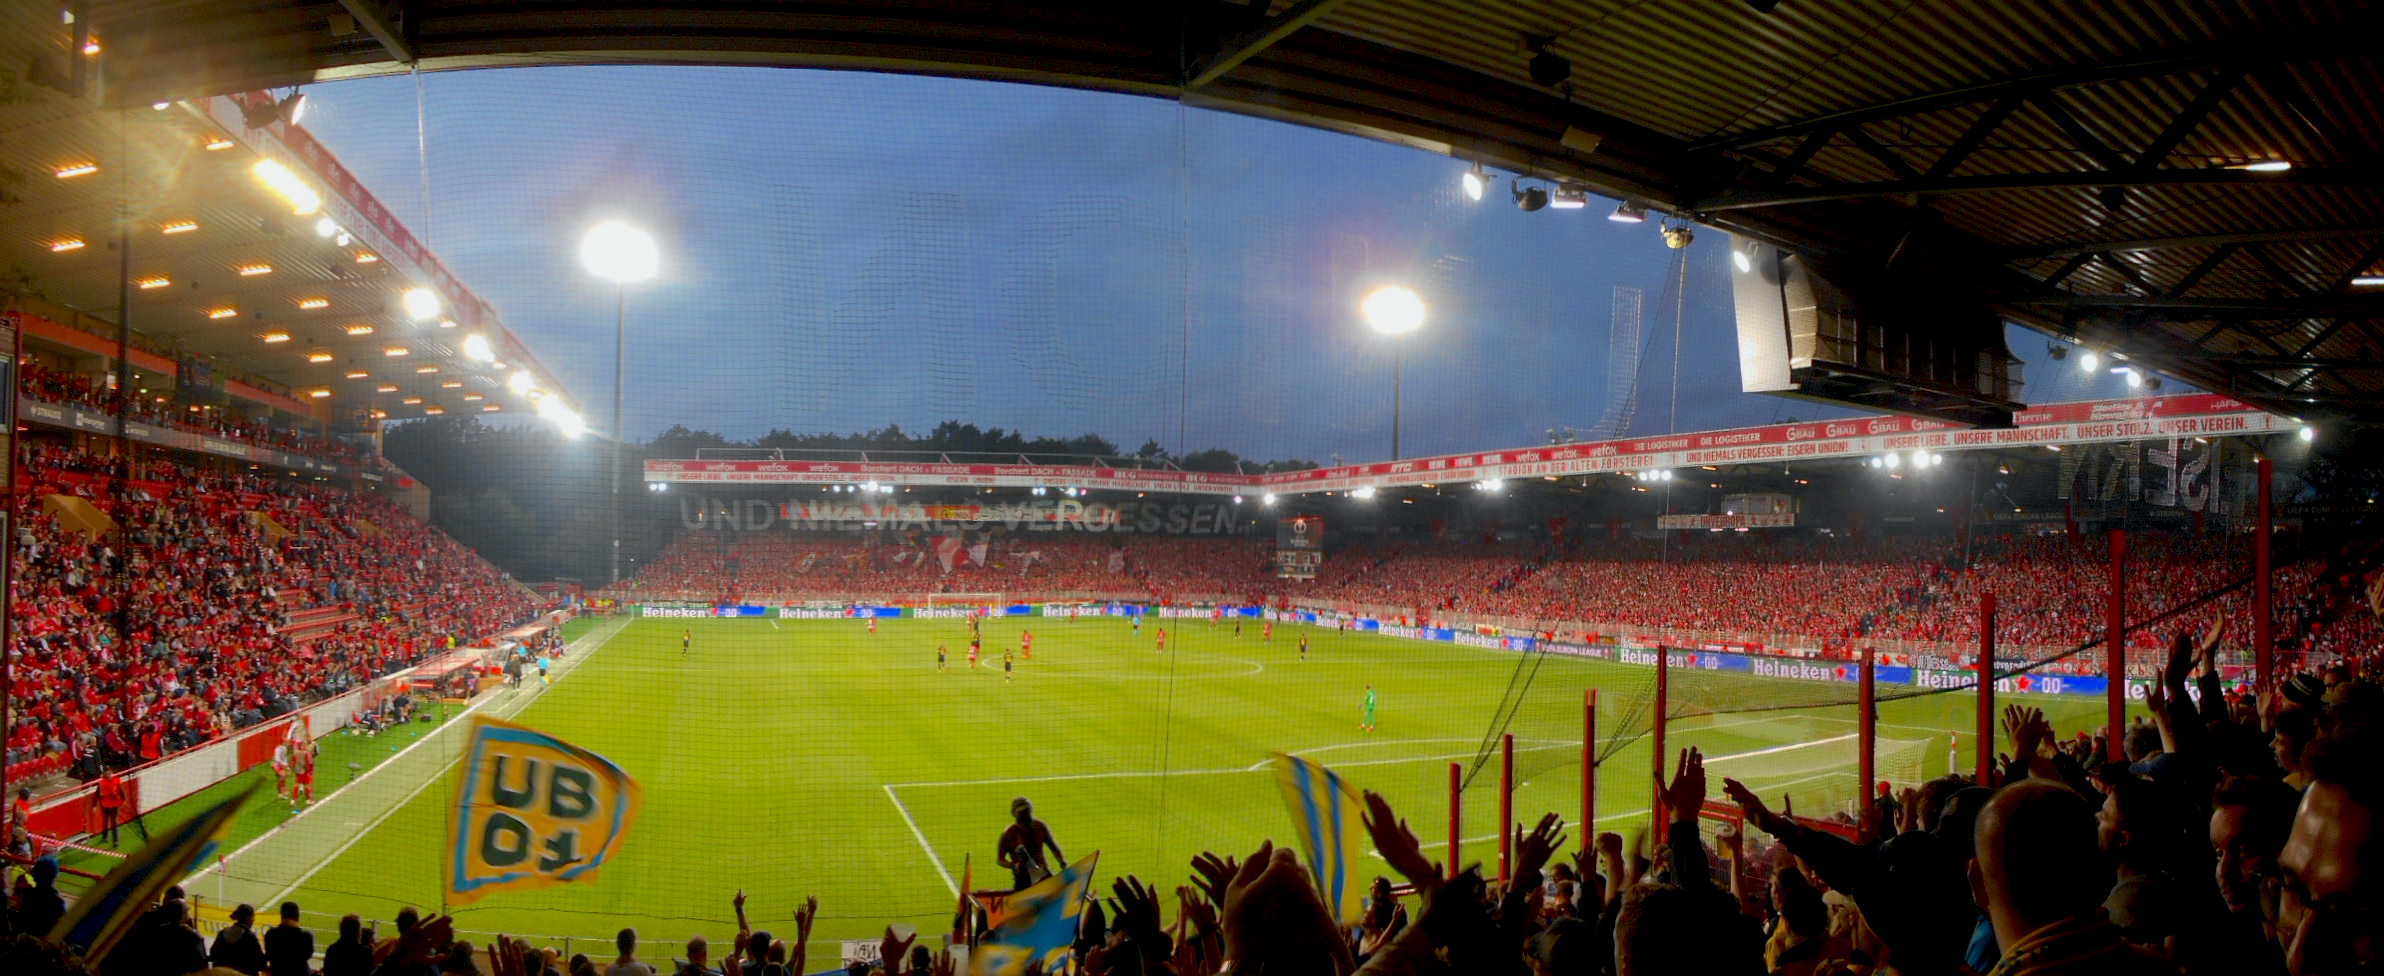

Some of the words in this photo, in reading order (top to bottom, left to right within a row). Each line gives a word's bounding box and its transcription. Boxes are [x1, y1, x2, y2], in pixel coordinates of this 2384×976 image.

[1884, 434, 1919, 449] UNSERE
[1954, 430, 1993, 445] UNSERE
[2077, 422, 2113, 439] UNSER
[2158, 416, 2201, 434] UNSER
[2201, 415, 2248, 432] VEREIN.
[1647, 439, 1688, 450] LOGISTIKER
[1700, 437, 1712, 445] DIE
[1715, 432, 1760, 445] LOGISTIKER
[1553, 448, 1577, 459] wefox
[1589, 443, 1617, 456] wefox
[1686, 452, 1701, 463] UND
[1703, 448, 1736, 462] NIEMALS
[1788, 443, 1816, 456] EISERN
[1516, 450, 1540, 462] wefox
[705, 463, 736, 472] wefox
[758, 463, 788, 472] wefox
[809, 464, 839, 472] wefox
[860, 464, 897, 473] Borchert
[899, 465, 921, 474] DACH
[931, 465, 970, 475] FASSADE
[994, 466, 1030, 475] Borchert
[1031, 467, 1054, 476] DACH
[1500, 463, 1532, 475] STADION
[1536, 462, 1548, 473] AN
[1570, 459, 1597, 472] ALTEN
[680, 497, 775, 531] UND
[642, 607, 707, 618] Heineken
[779, 608, 843, 619] Heineken
[1159, 607, 1215, 618] Heineken
[1379, 623, 1419, 638] Heineken
[1455, 632, 1500, 649] Heineken
[1579, 647, 1602, 657] LEAGUE
[1621, 649, 1684, 668] Heineen
[1753, 658, 1831, 679] Heineken
[492, 754, 597, 820] UB
[482, 812, 585, 873] 01
